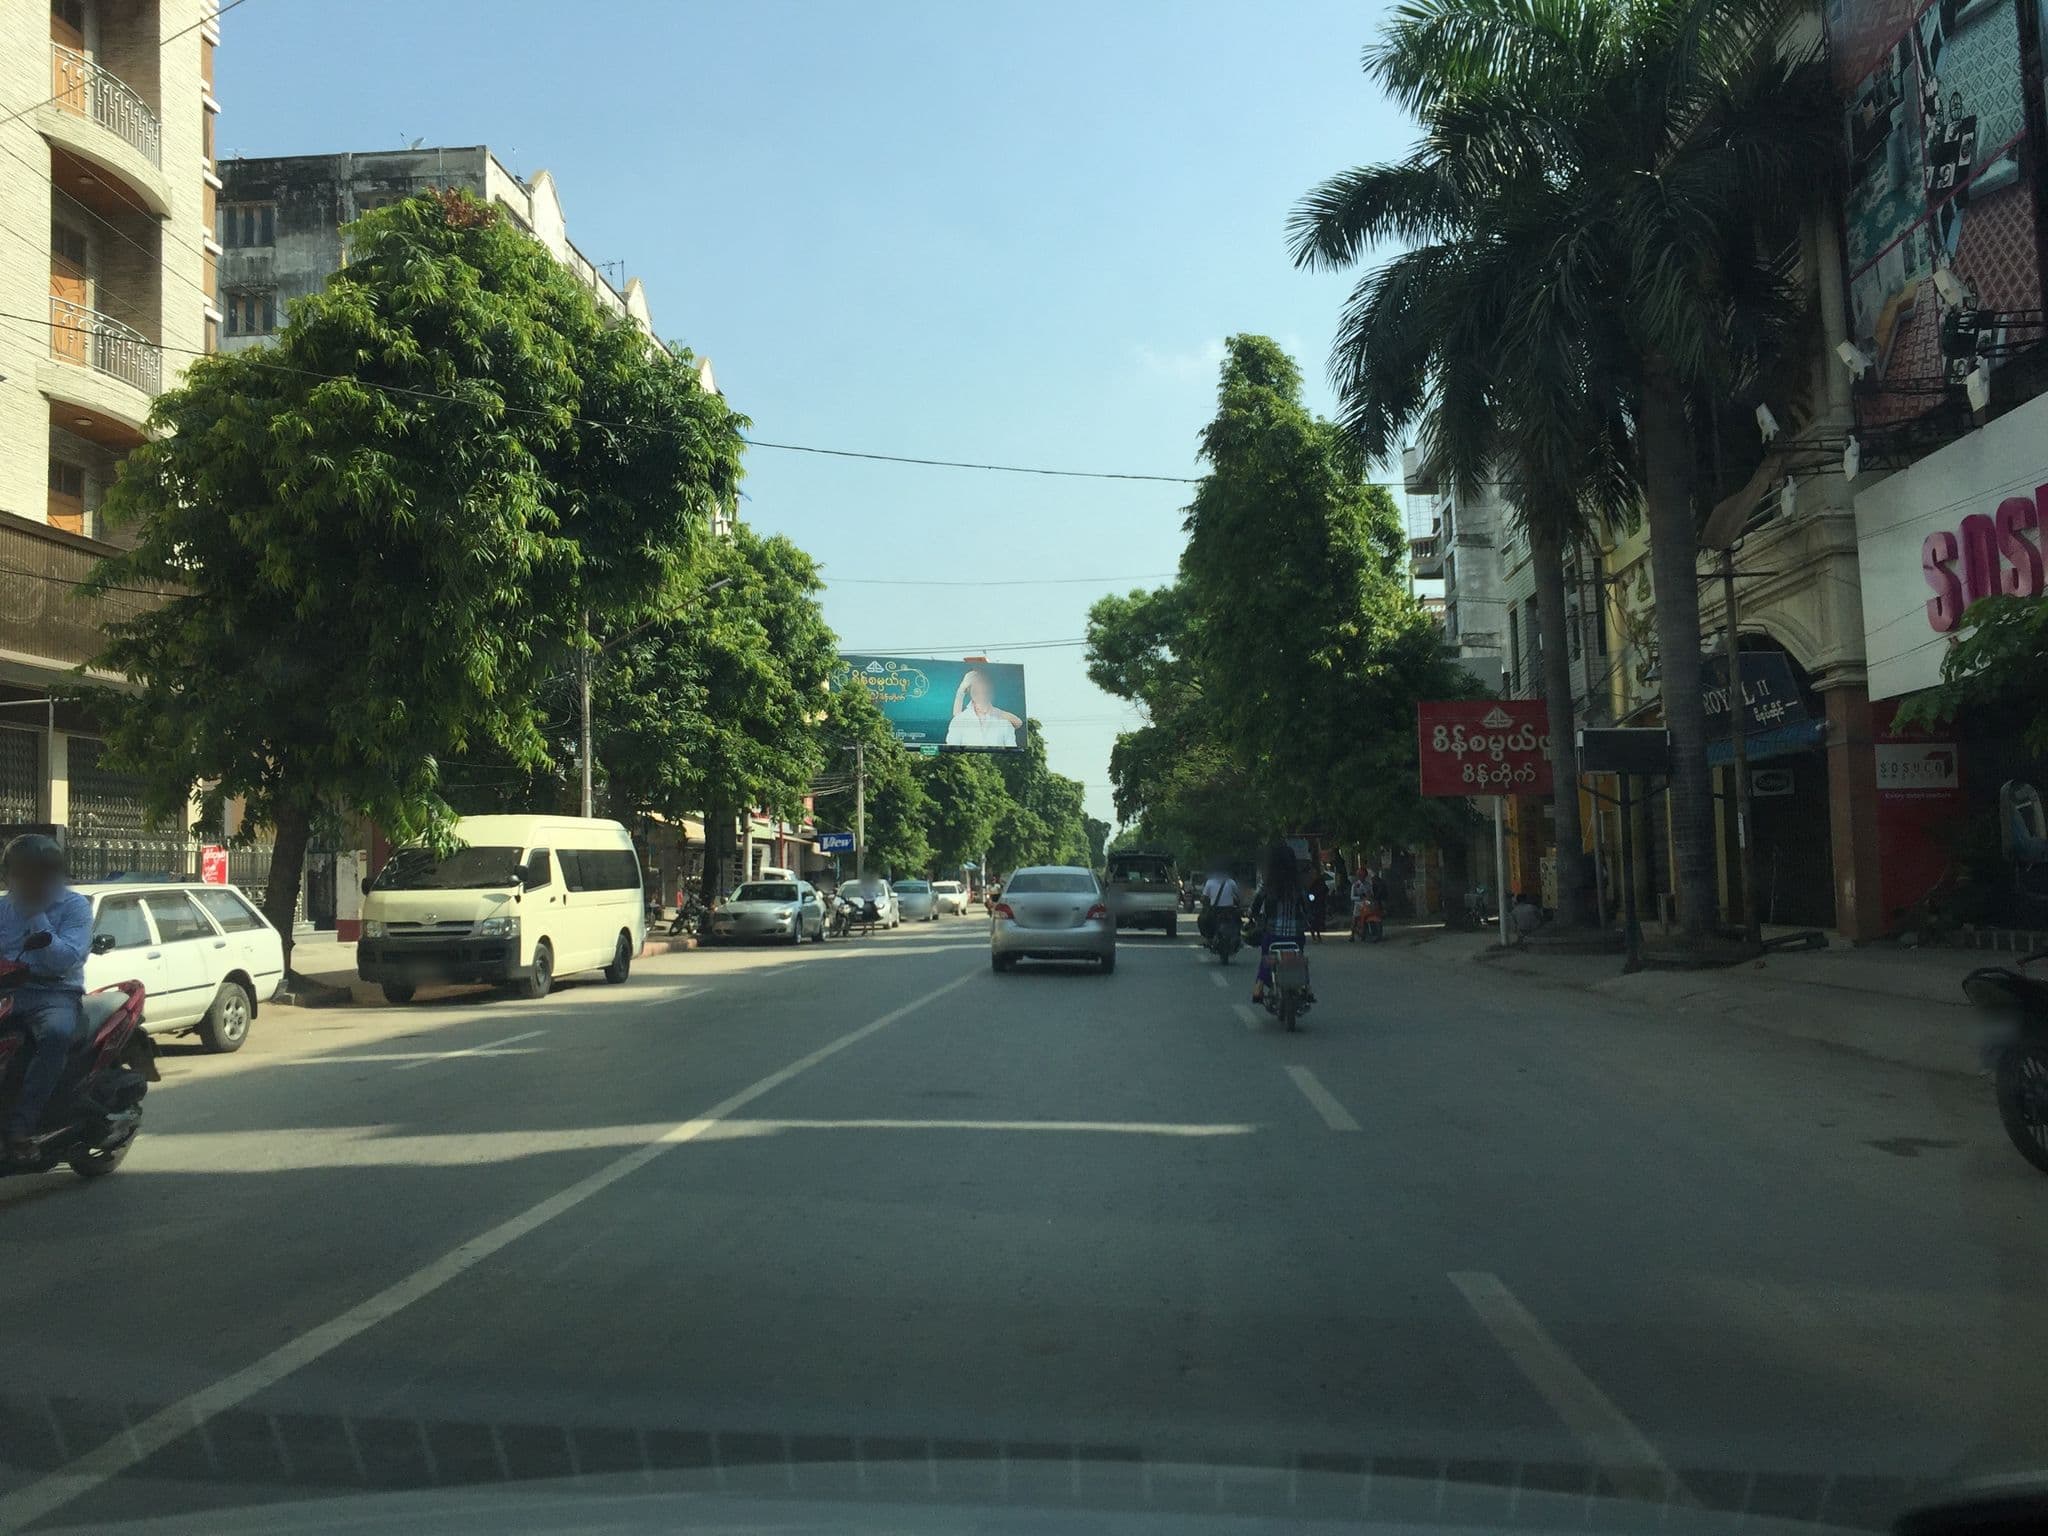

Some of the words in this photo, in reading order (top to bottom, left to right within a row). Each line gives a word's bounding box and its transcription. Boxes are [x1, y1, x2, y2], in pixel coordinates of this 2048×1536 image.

[1702, 680, 1756, 716] ROYL
[1462, 762, 1536, 789] စိန်တိုက်
